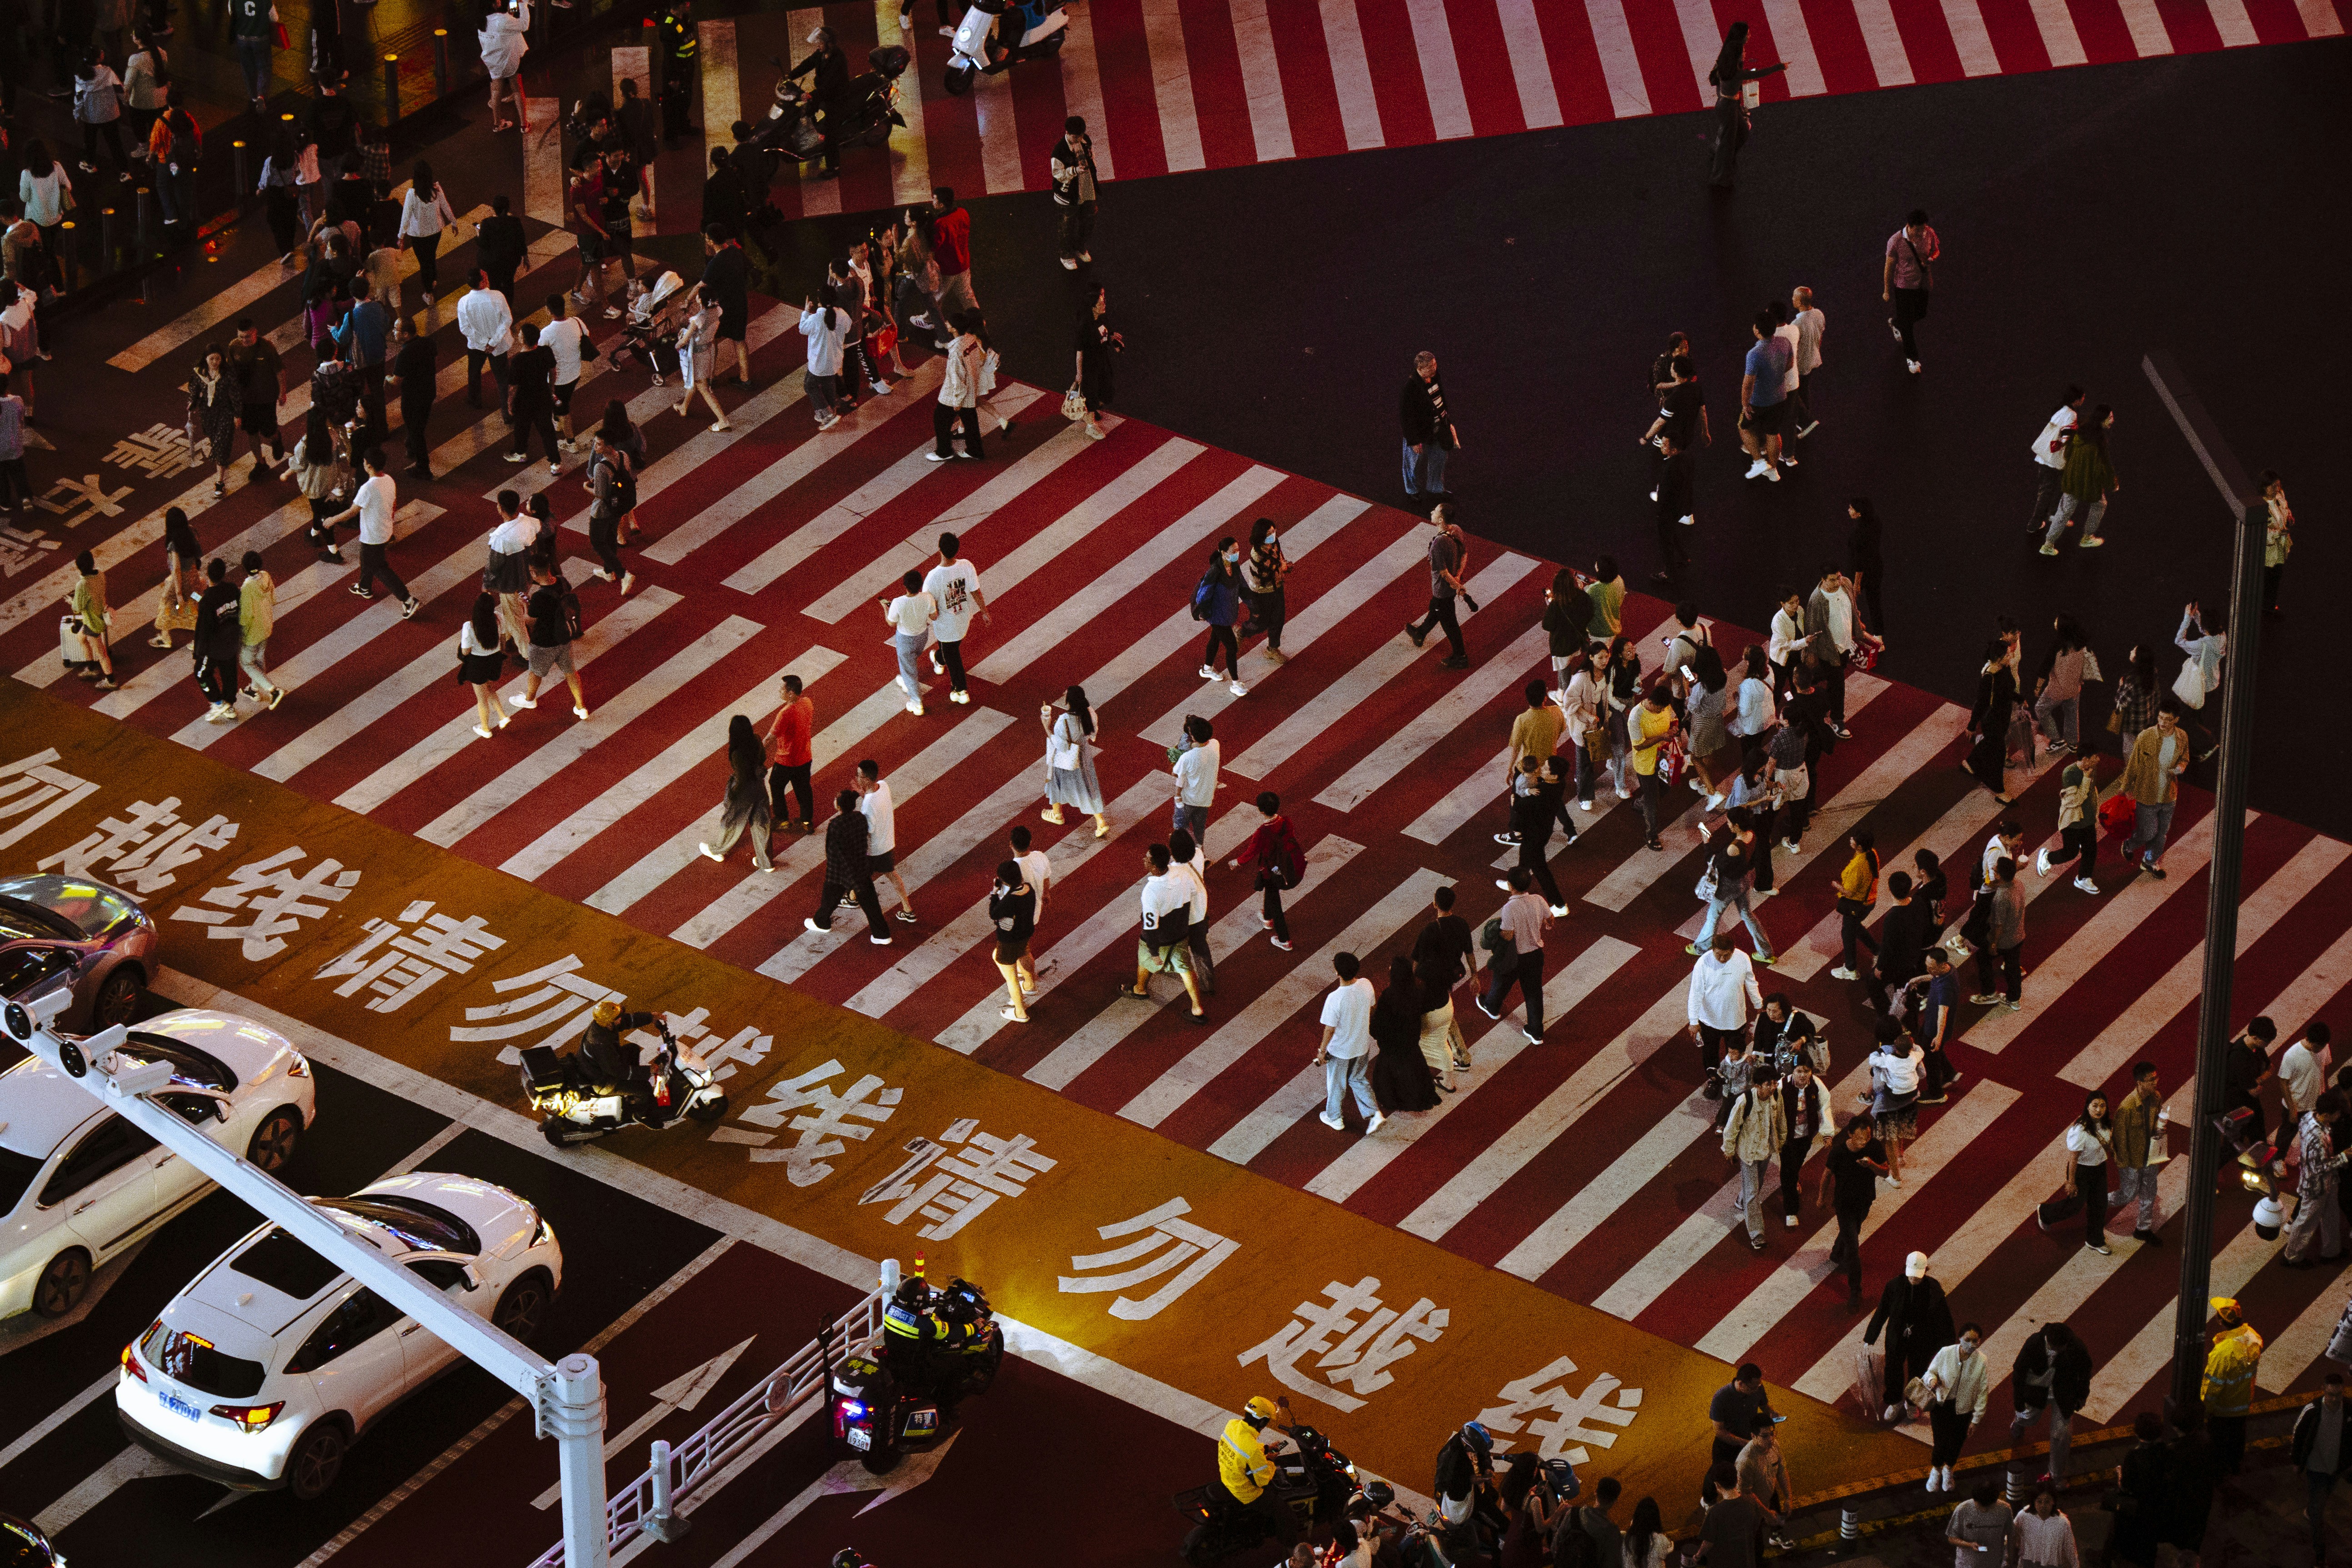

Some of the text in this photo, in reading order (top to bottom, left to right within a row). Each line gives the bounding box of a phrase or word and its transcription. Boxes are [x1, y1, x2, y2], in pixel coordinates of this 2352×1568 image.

[244, 0, 255, 16] C
[1146, 912, 1155, 927] S
[893, 1309, 909, 1322] SWAT
[848, 1359, 879, 1376] 特警
[914, 1413, 931, 1424] 特警
